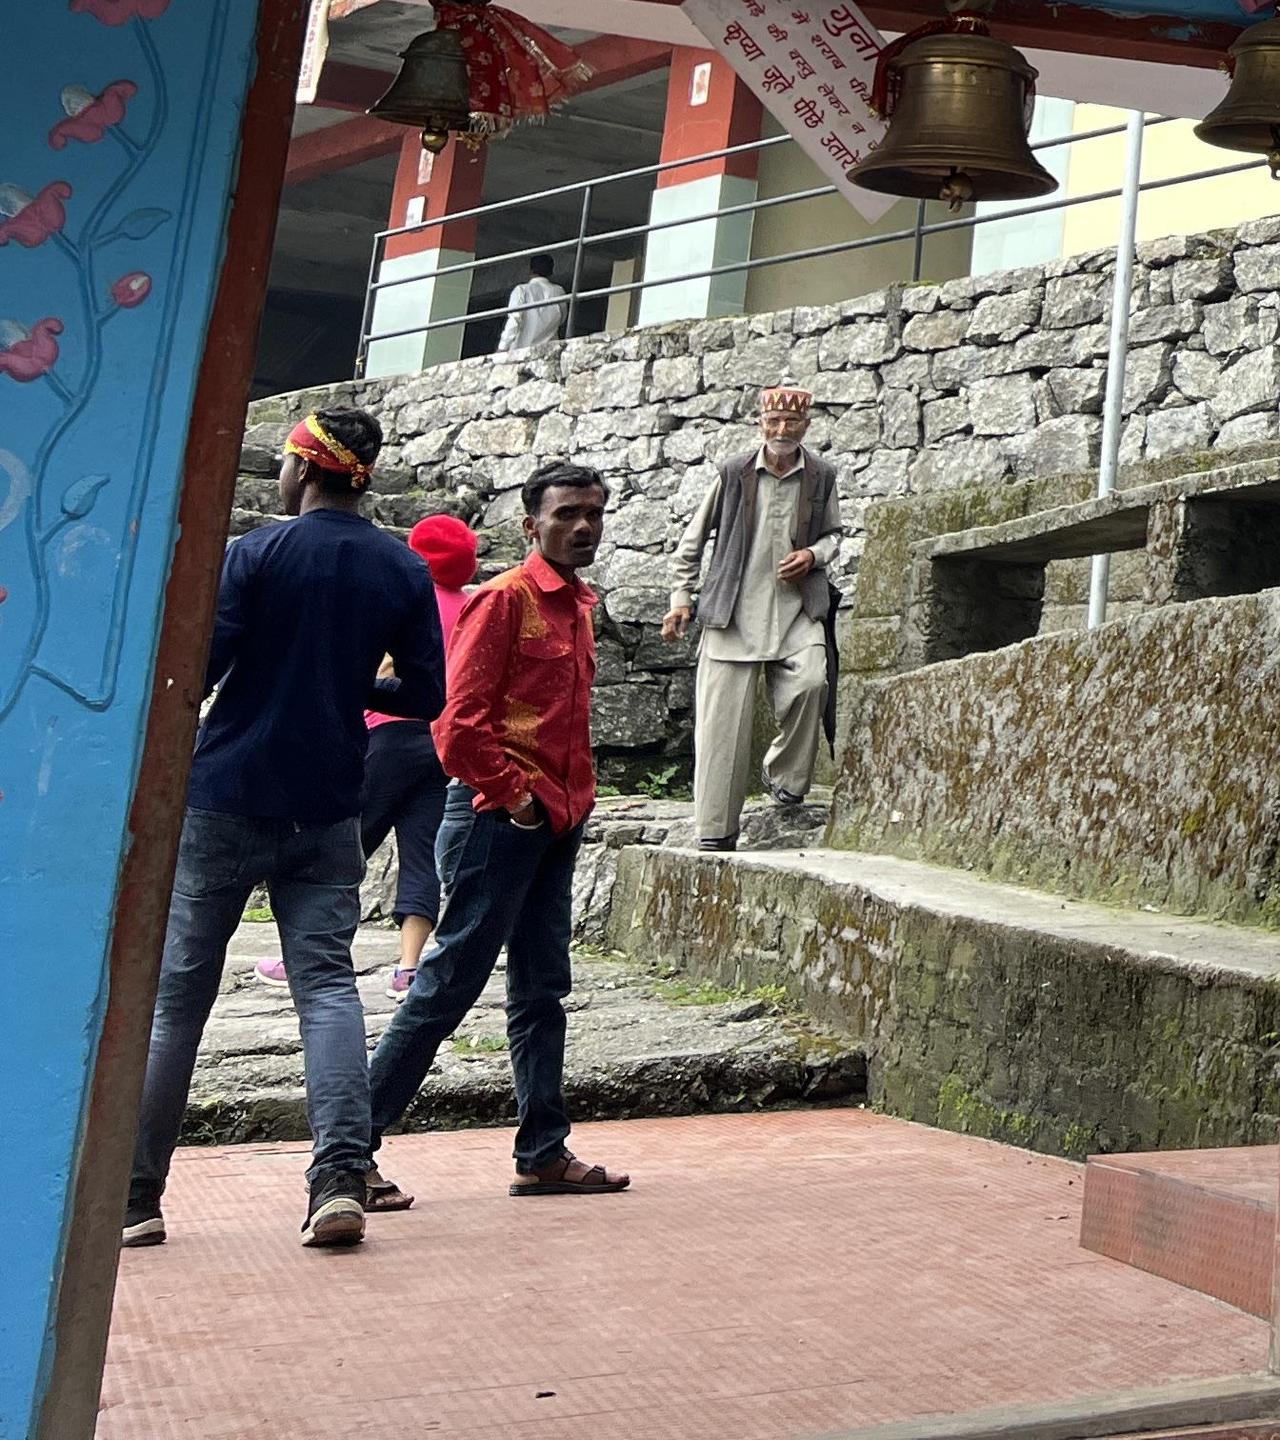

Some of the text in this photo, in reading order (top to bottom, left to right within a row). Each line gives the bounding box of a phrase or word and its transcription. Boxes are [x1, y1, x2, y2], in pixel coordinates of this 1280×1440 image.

[791, 9, 810, 26] में
[811, 33, 847, 70] शराब
[849, 77, 874, 106] पीक
[822, 4, 884, 61] गुना
[762, 64, 796, 95] जूते
[793, 97, 826, 130] पीछे
[767, 23, 788, 44] की
[817, 82, 851, 117] लेकर
[851, 121, 867, 135] न
